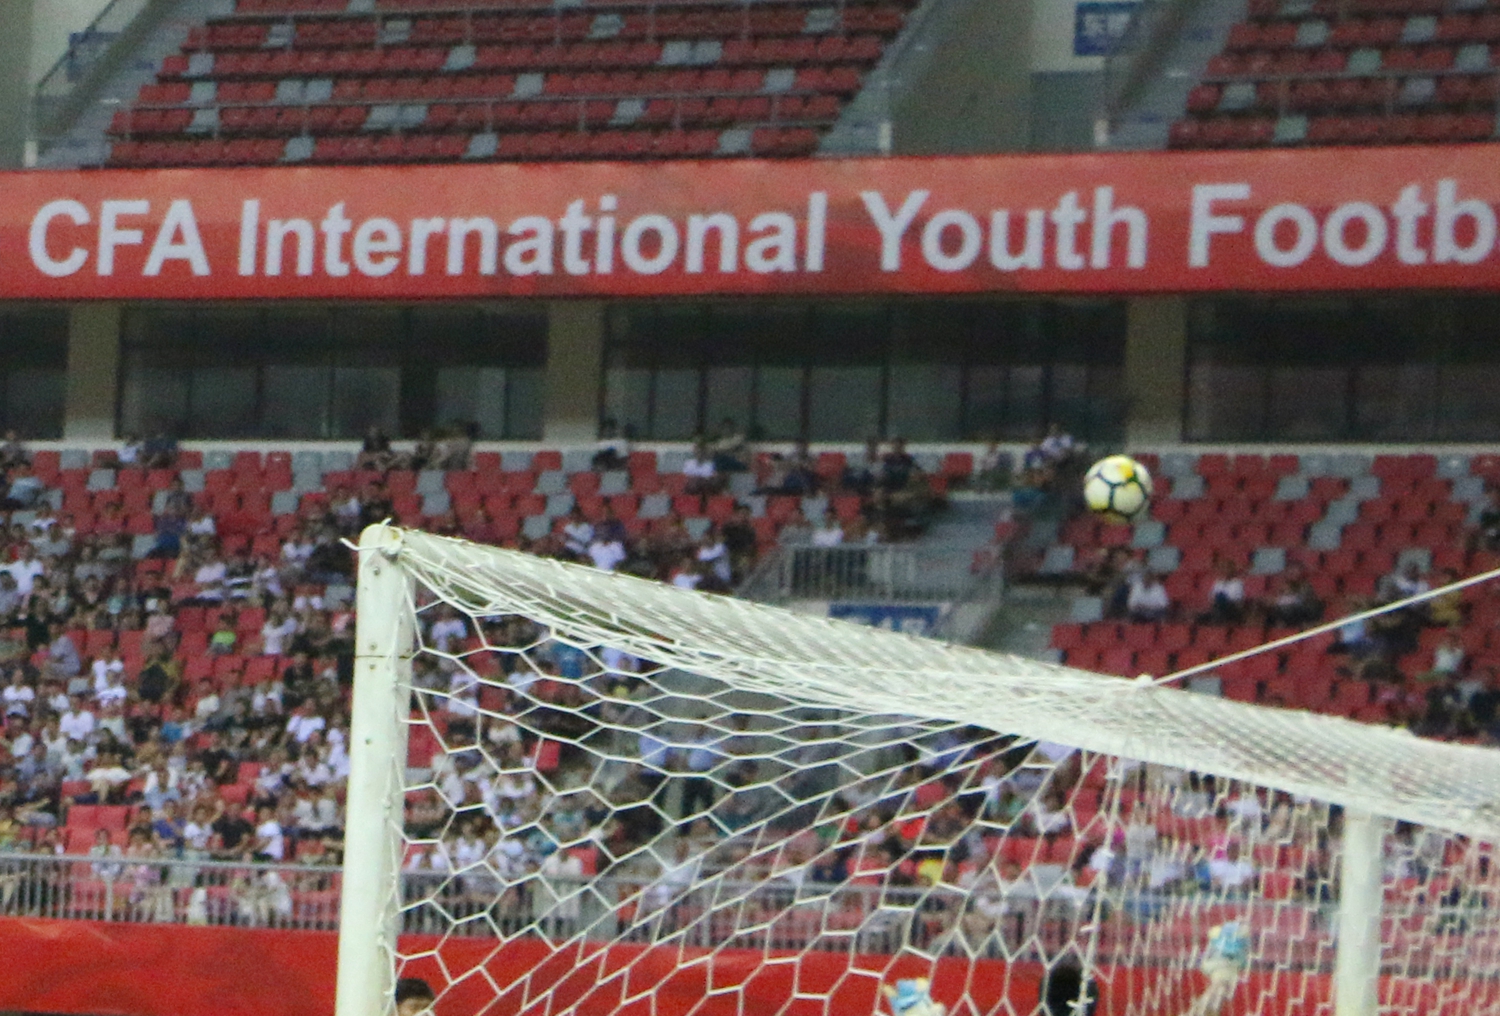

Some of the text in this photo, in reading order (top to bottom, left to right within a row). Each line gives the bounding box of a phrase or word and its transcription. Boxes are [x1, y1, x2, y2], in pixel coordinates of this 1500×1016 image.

[28, 199, 211, 277] CFA
[237, 190, 828, 277] International
[861, 187, 1149, 272] Youth
[1187, 178, 1498, 269] Footb
